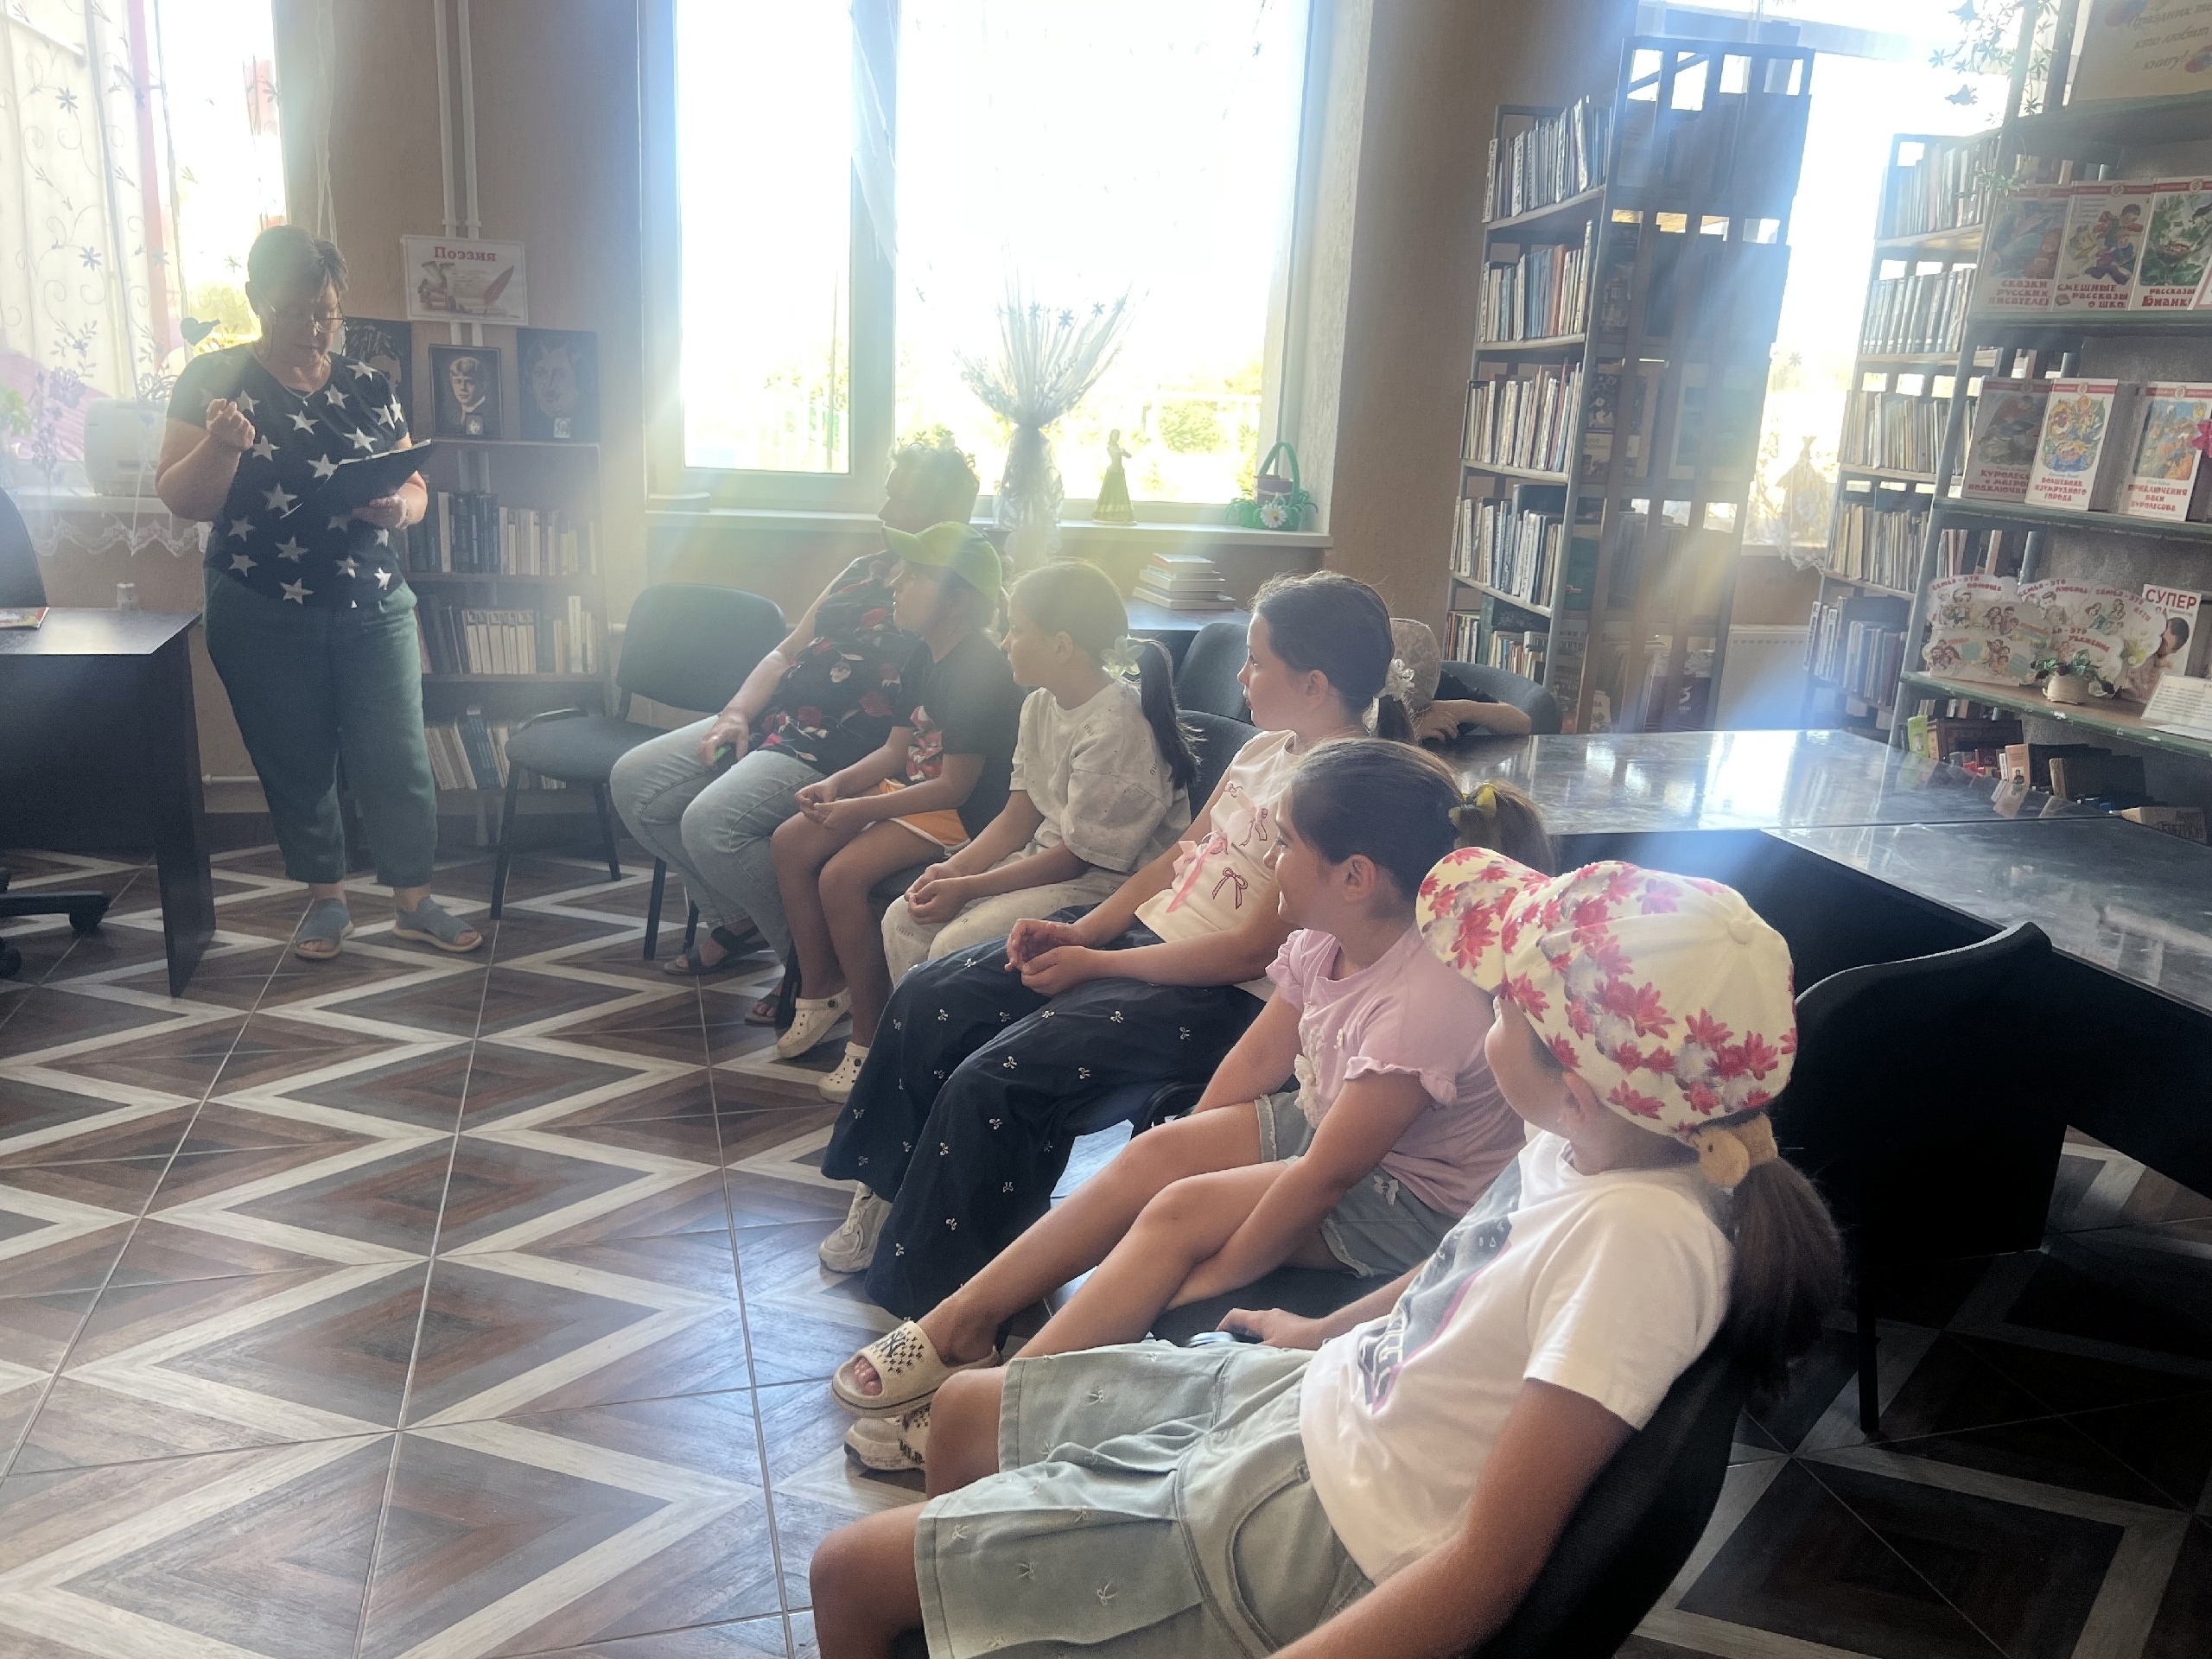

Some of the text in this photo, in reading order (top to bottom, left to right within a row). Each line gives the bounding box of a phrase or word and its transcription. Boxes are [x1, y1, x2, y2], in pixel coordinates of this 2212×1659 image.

[2133, 24, 2209, 49] кто любит
[2144, 49, 2189, 70] книгу!
[434, 246, 497, 261] Поэзия
[1993, 479, 2029, 487] МАТРО
[2041, 477, 2083, 487] ВОЛШЕБНИК
[2034, 484, 2088, 495] ИЗУМРУДНОГО
[2127, 484, 2188, 496] ПРИКЛЮЧЕНИЯ
[2044, 493, 2072, 501] ГОРОДА
[2145, 588, 2197, 610] СУПЕР
